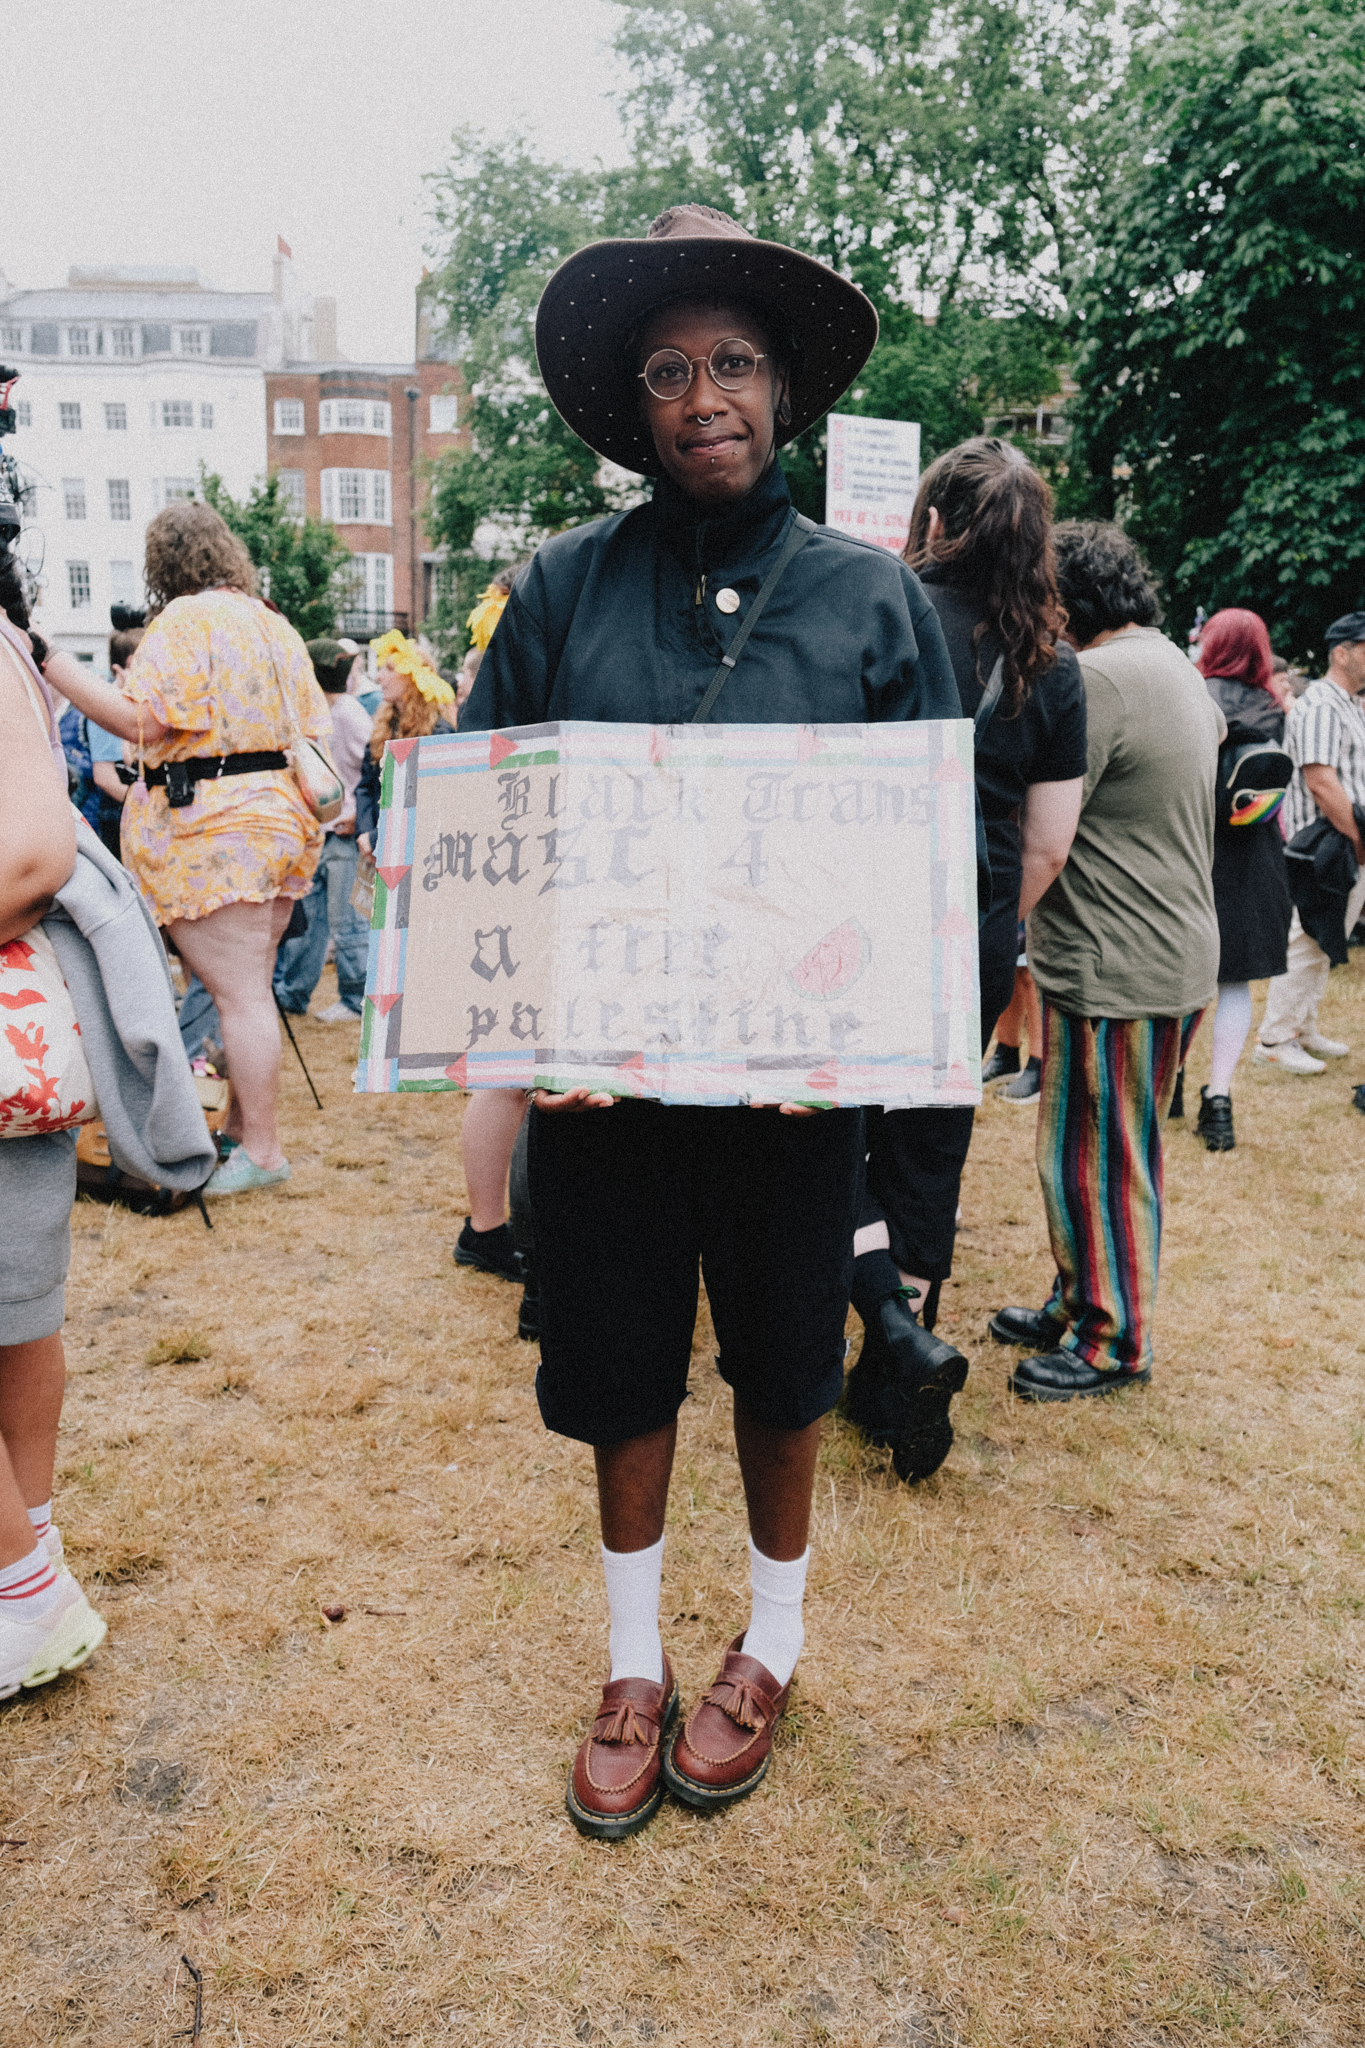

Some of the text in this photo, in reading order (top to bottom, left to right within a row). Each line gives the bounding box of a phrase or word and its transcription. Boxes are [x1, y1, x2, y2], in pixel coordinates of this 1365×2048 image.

[497, 770, 936, 831] Black Trans
[717, 829, 769, 888] 4
[470, 916, 732, 983] a free
[465, 995, 863, 1052] palestine
